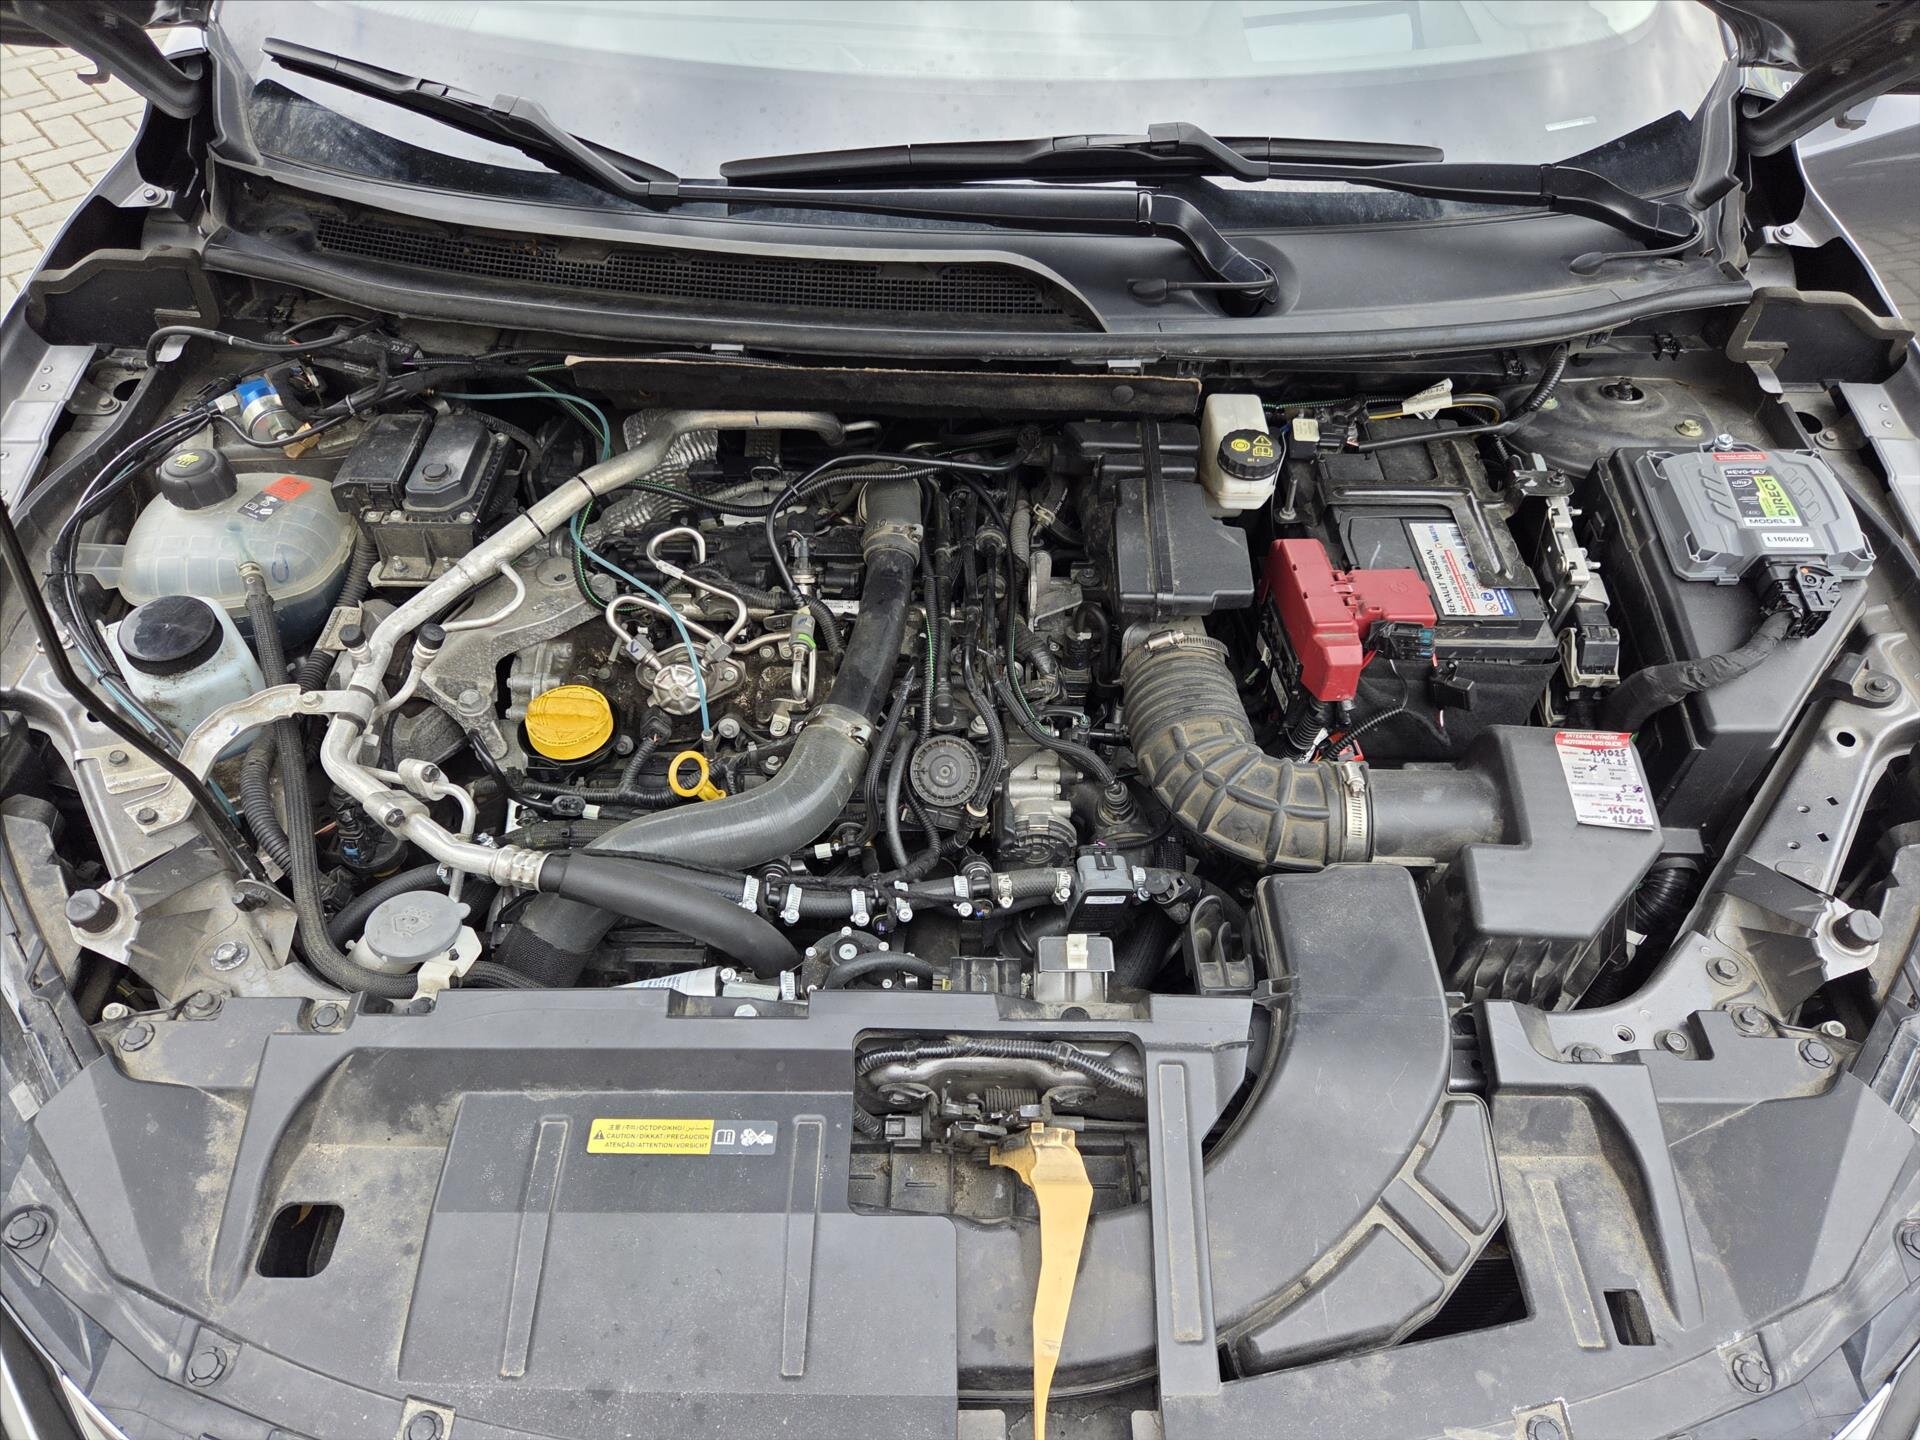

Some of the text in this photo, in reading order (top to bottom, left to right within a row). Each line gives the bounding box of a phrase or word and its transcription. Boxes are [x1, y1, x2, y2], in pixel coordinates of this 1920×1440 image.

[1760, 477, 1790, 516] DIRECT
[1424, 549, 1457, 613] RENAULT NISSAN
